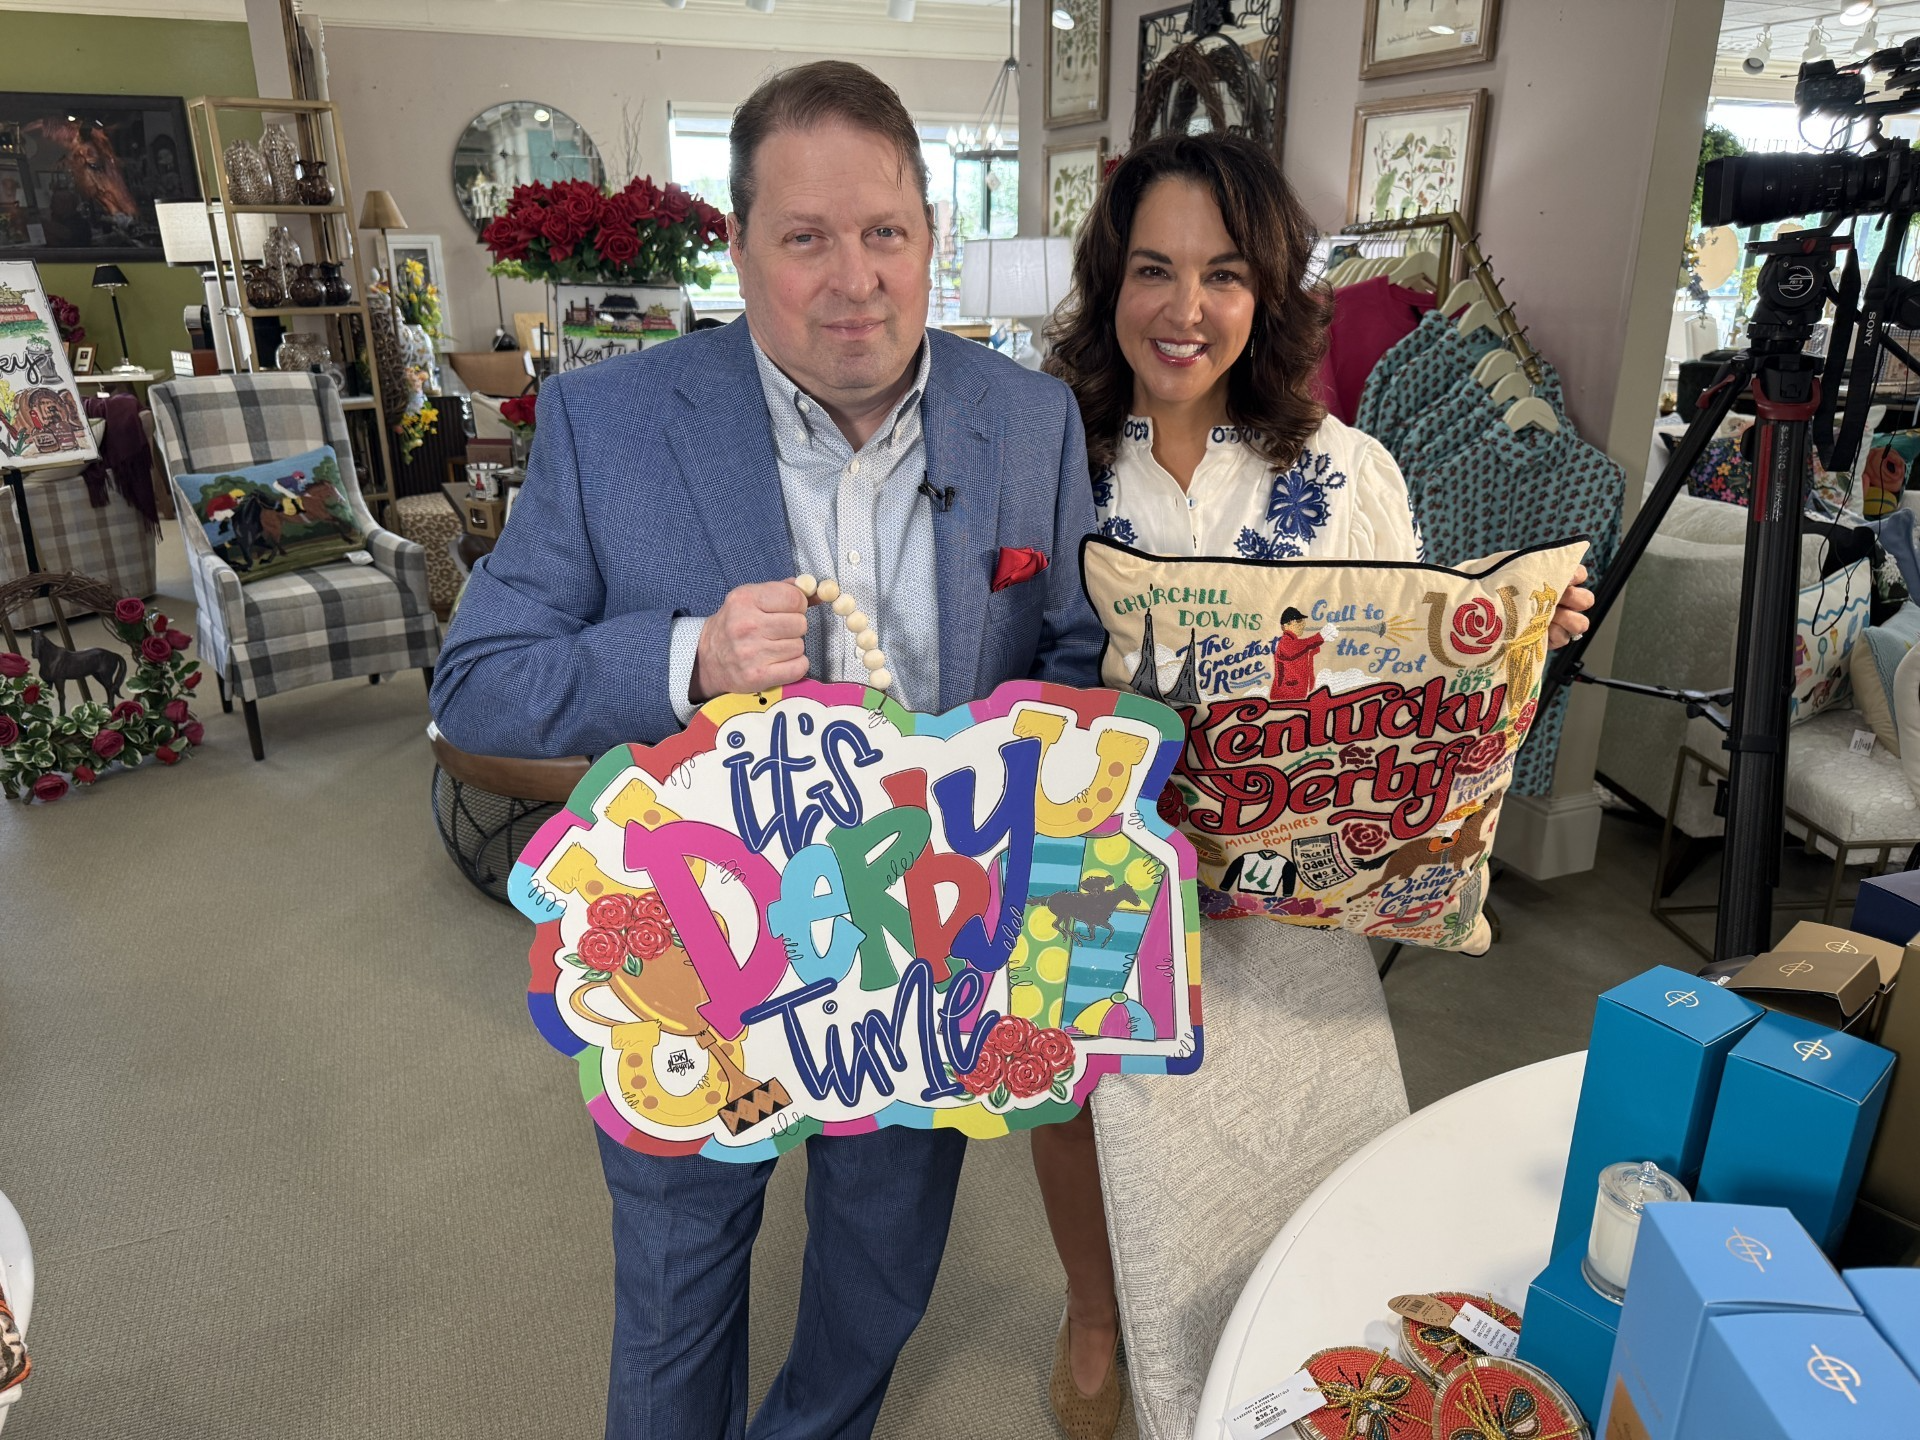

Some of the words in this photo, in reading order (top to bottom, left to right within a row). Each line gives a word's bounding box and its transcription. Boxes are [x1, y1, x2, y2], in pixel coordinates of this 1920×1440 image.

[1863, 311, 1877, 347] SONY
[562, 334, 643, 371] Kent
[0, 352, 45, 385] ey
[1113, 586, 1232, 615] CHURCHILL
[1311, 599, 1356, 623] Call
[1363, 603, 1384, 620] to
[1178, 609, 1263, 631] DOWNS
[1178, 634, 1234, 658] The
[1336, 638, 1370, 656] the
[1368, 646, 1427, 674] Post
[1198, 635, 1282, 690] Greatest
[1456, 666, 1492, 678] SINCE
[1208, 660, 1265, 695] Race
[1449, 672, 1495, 693] 1875
[1177, 676, 1507, 780] Kentucky
[1182, 736, 1474, 840] Derby
[1224, 816, 1319, 849] MILLIONAIRES
[1263, 832, 1292, 848] ROW
[1420, 865, 1453, 881] The
[1378, 887, 1444, 914] Circle
[1396, 923, 1442, 933] WINNER
[673, 1052, 686, 1063] DK
[1255, 1406, 1279, 1422] $36.25
